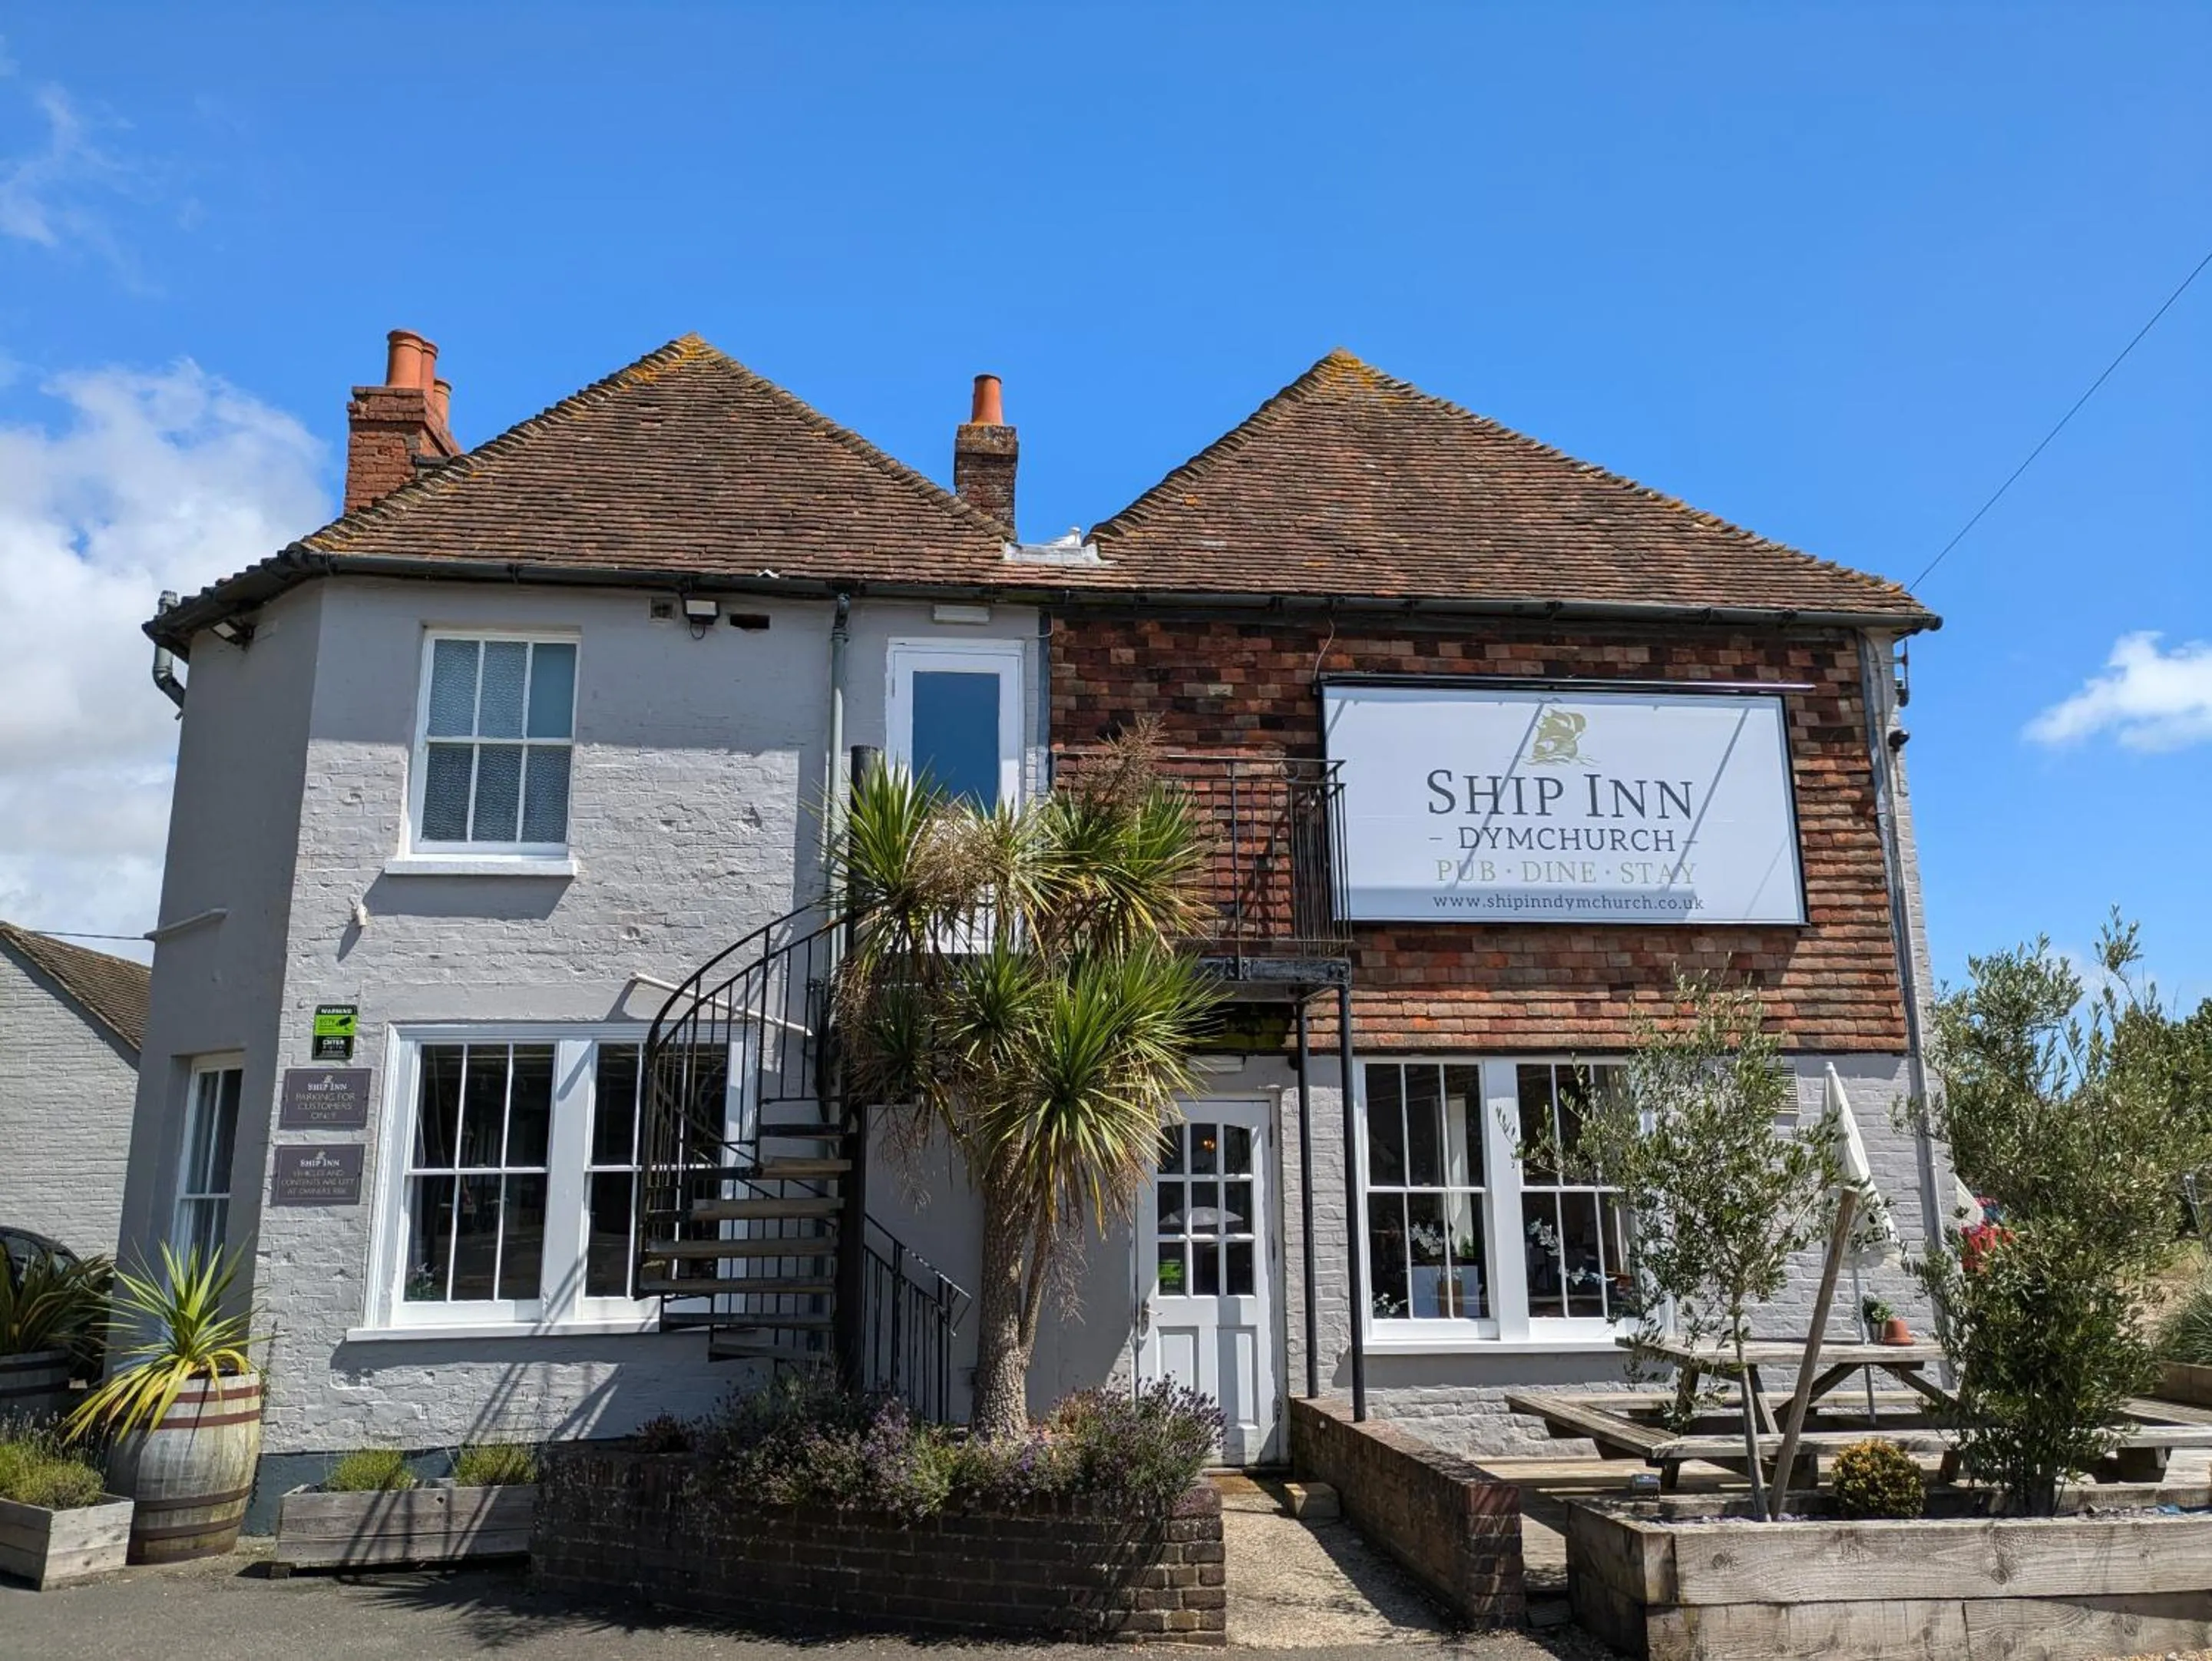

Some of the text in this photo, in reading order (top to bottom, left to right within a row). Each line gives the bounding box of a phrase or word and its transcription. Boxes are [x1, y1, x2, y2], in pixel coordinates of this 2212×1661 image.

[1427, 769, 1693, 820] SHIP INN
[1458, 826, 1676, 852] DYMCHURCH
[1436, 859, 1697, 885] PUB DINE STAY
[1433, 893, 1705, 912] www.shipinndymchurch.co.uk
[307, 1082, 348, 1091] SHIP INN
[296, 1092, 355, 1101] PARKING FOR
[299, 1158, 341, 1167] SHIP INN
